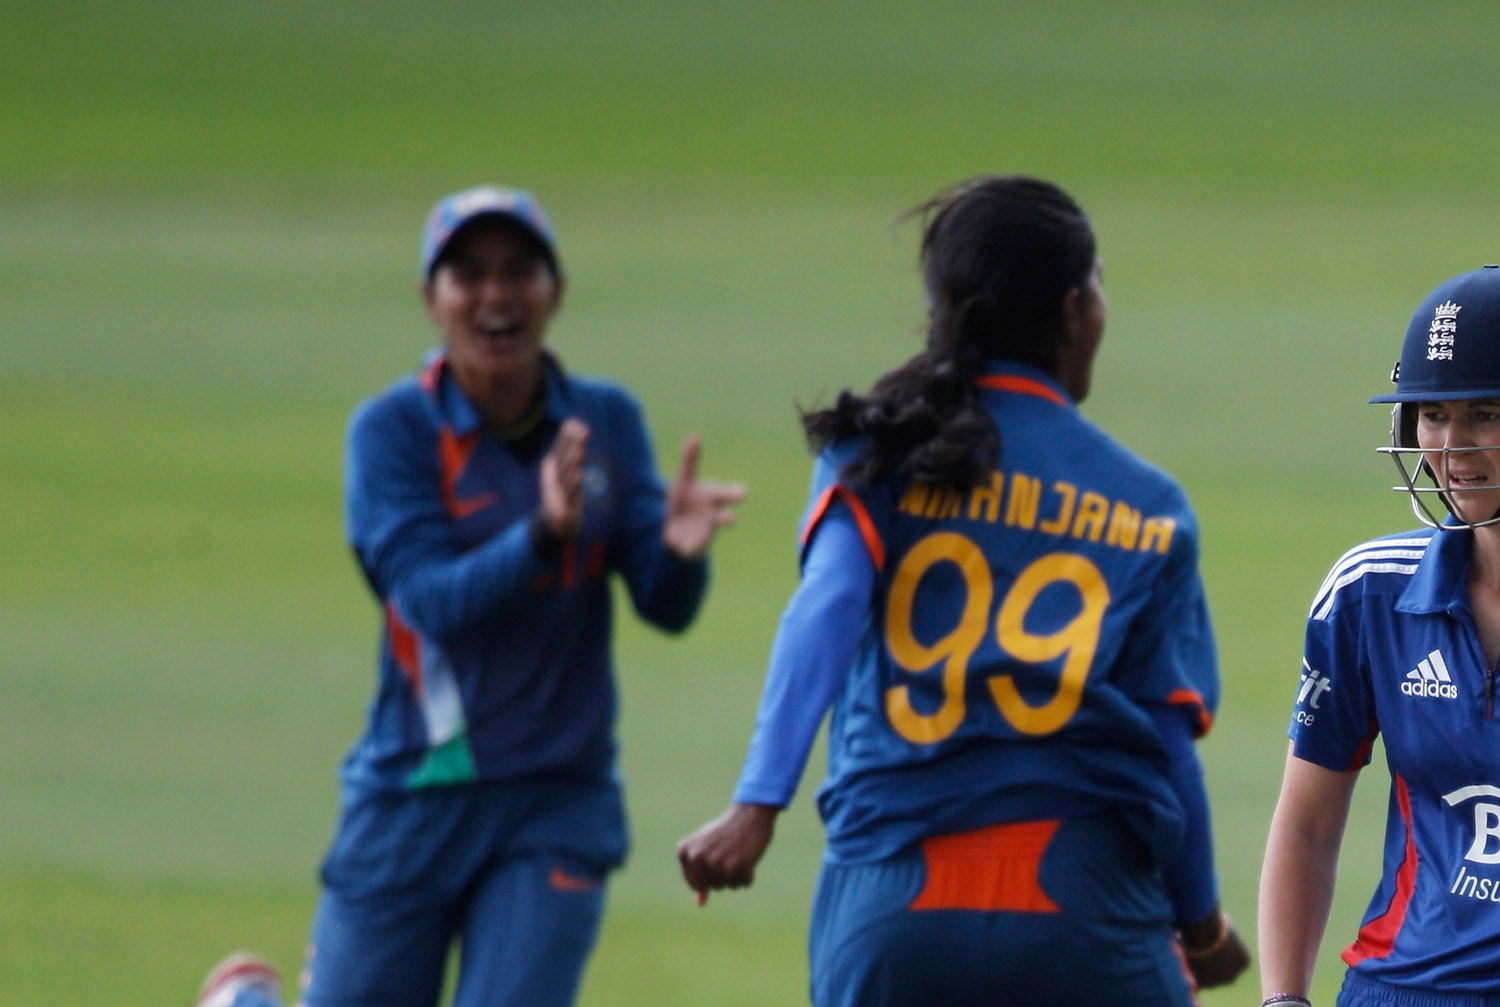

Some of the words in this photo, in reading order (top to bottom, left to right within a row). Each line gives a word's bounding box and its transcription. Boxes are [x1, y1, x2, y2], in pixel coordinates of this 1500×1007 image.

[884, 531, 1111, 744] 99
[1296, 669, 1331, 709] it
[1400, 679, 1458, 699] adidas
